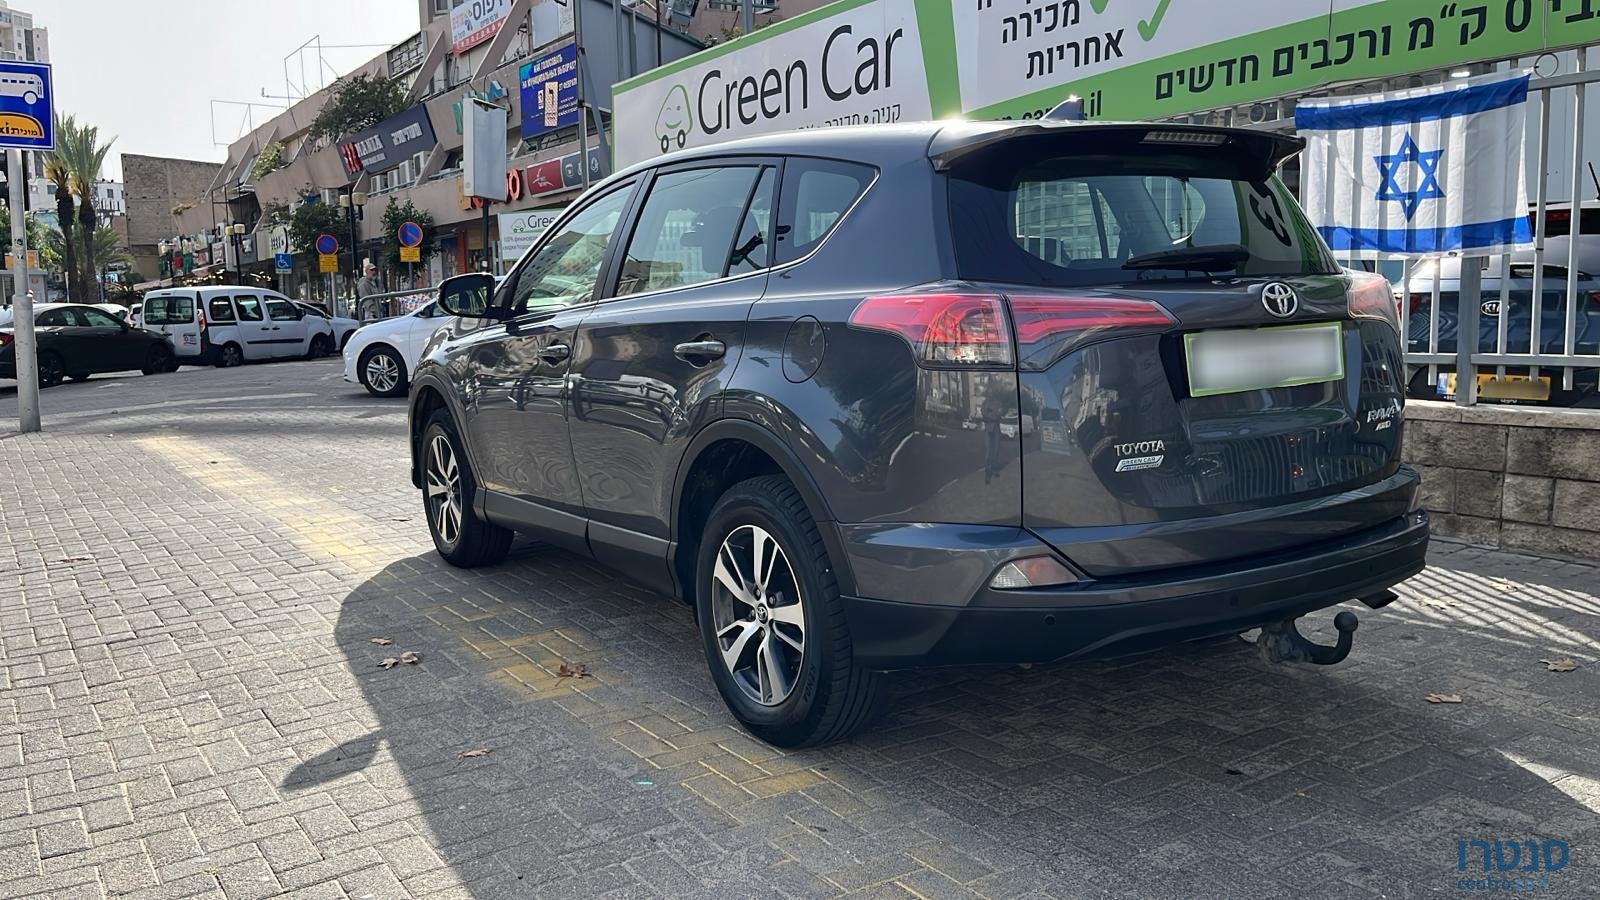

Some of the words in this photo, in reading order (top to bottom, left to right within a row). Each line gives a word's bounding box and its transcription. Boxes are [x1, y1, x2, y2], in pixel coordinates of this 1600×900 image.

[1002, 0, 1080, 44] מכירה
[1026, 28, 1125, 79] אחריות
[1272, 25, 1391, 79] ורכבים
[697, 59, 808, 135] Green
[821, 24, 903, 102] Car
[1155, 54, 1259, 100] חדשים
[11, 127, 38, 136] מונית
[872, 104, 901, 124] קניה
[1113, 439, 1166, 457] TOYOTA
